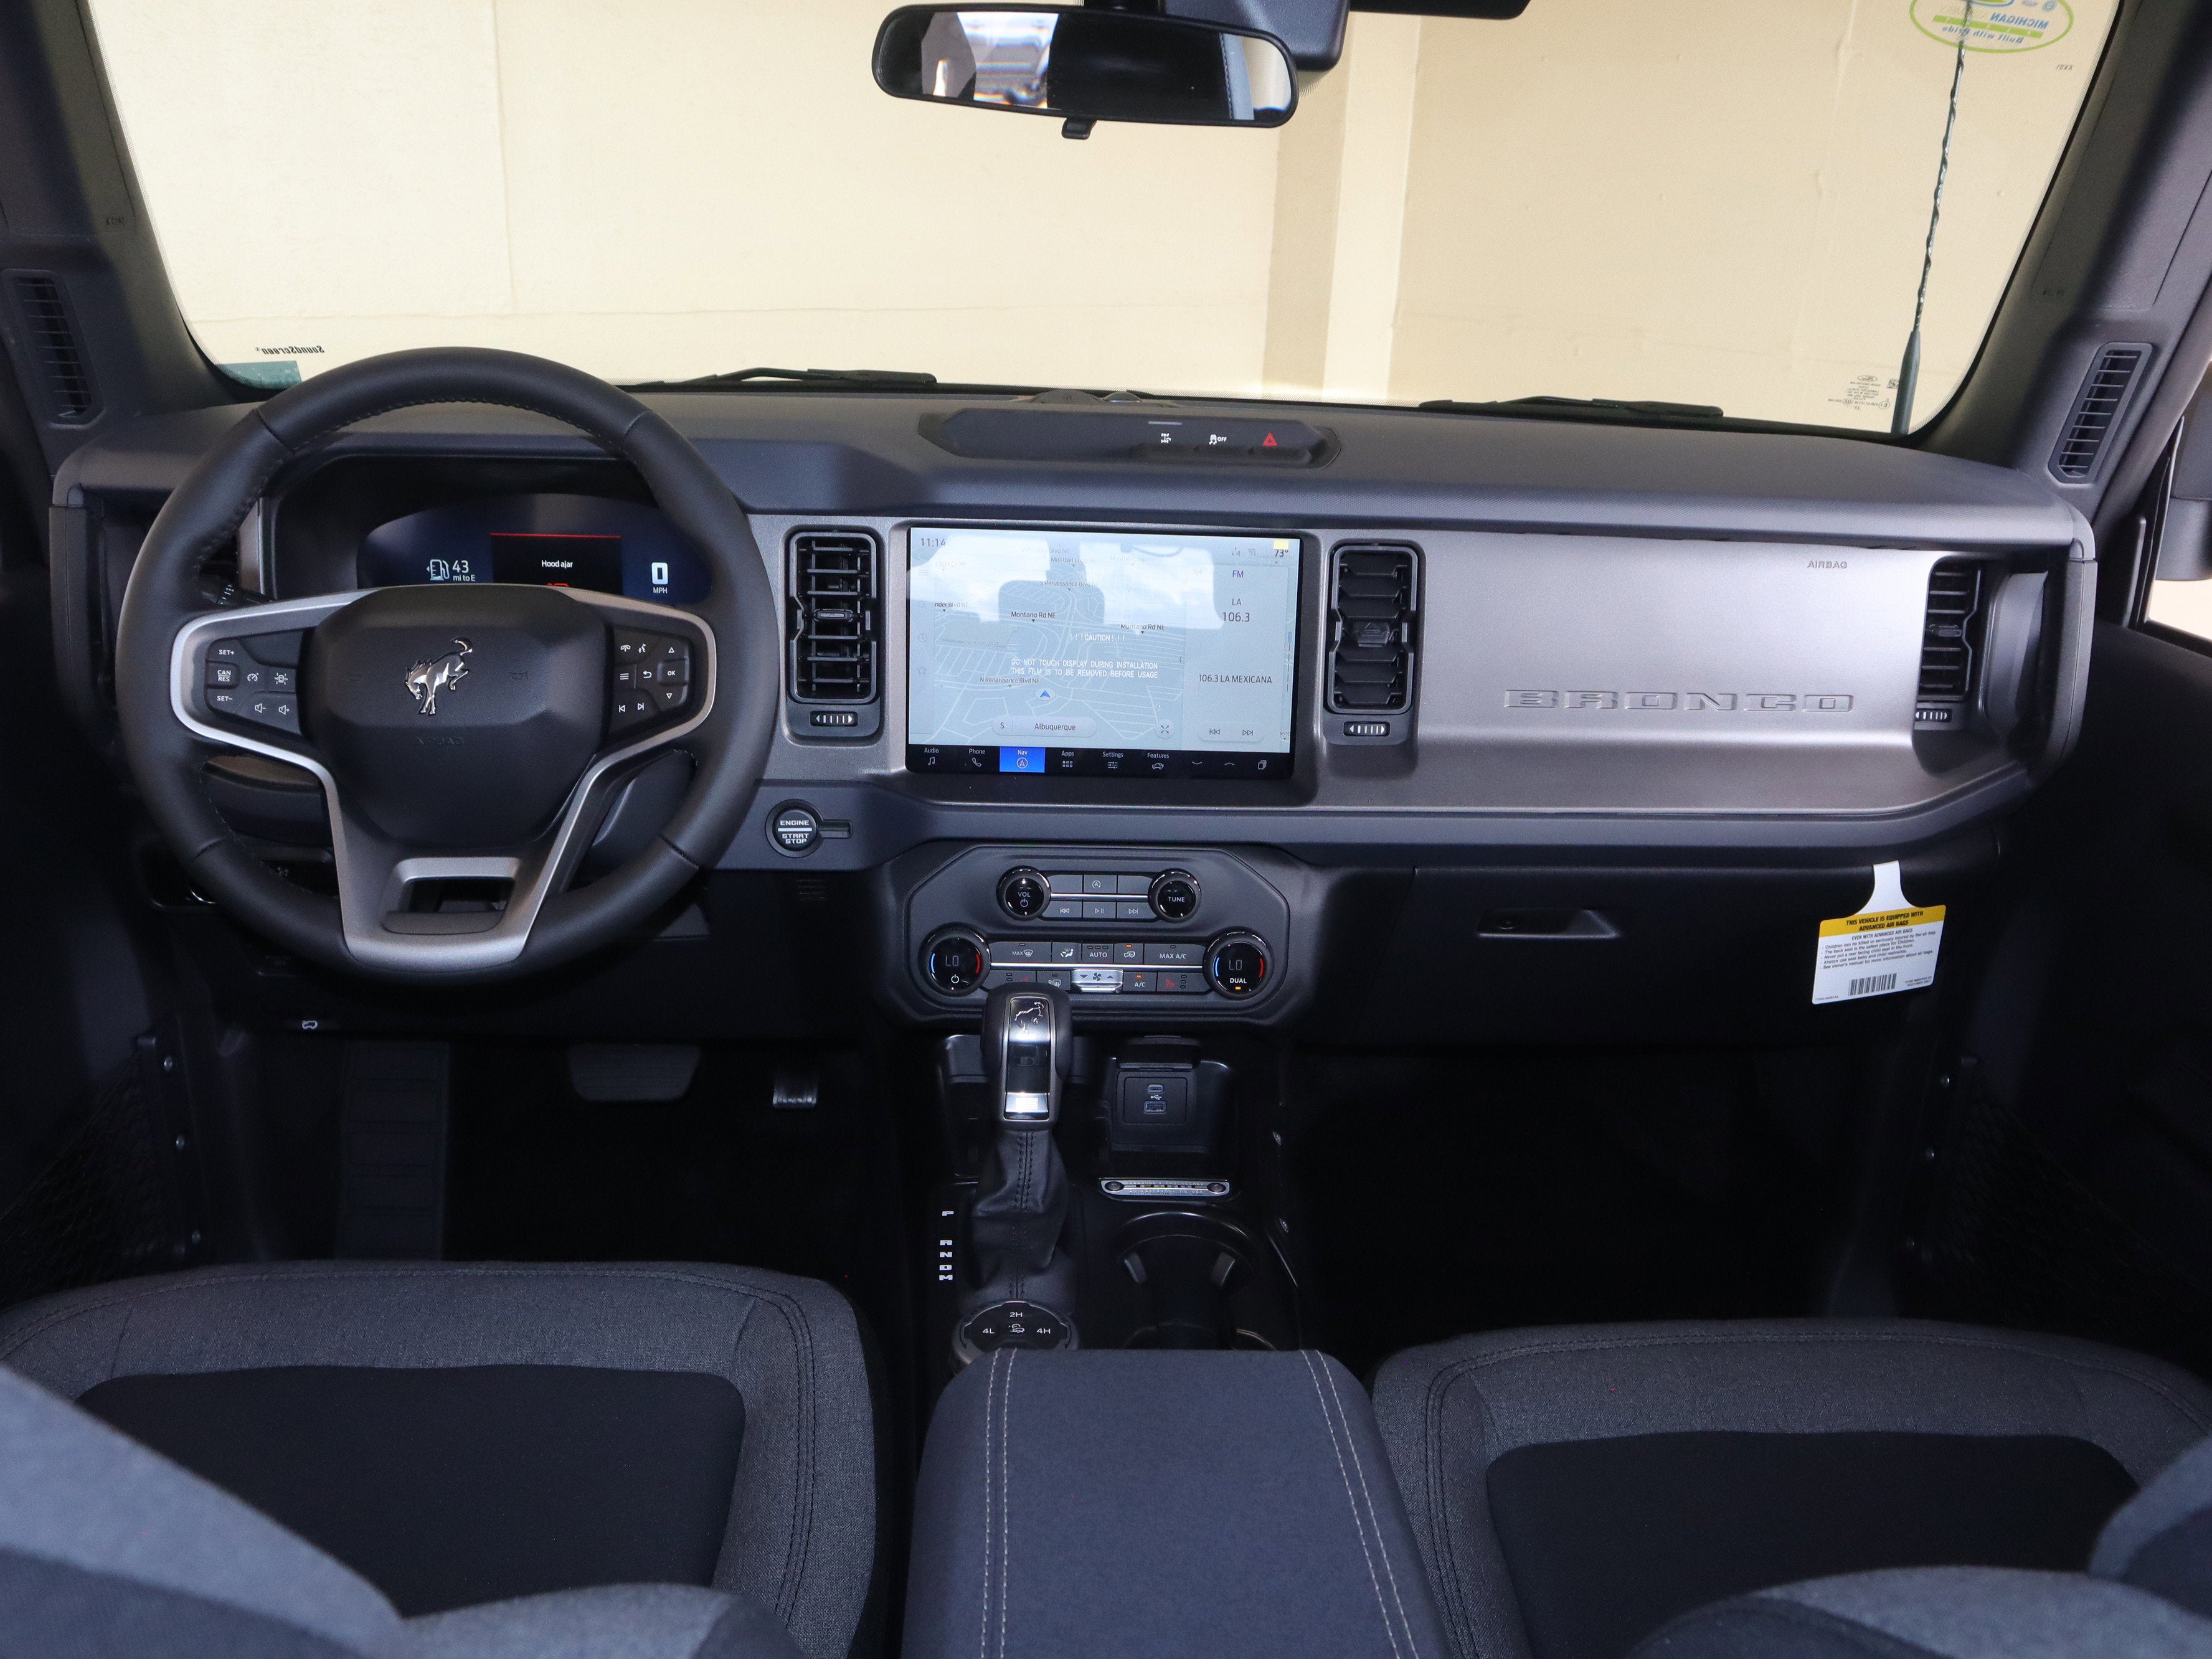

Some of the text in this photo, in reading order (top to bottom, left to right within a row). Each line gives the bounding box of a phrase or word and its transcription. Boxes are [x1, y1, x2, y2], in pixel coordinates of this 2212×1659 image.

[921, 538, 945, 547] 11:14
[452, 560, 469, 573] 43
[560, 560, 574, 569] ajar
[1807, 560, 1848, 569] AIRBAG
[651, 562, 668, 585] 0
[1222, 612, 1250, 622] 106.3
[1199, 674, 1219, 683] 106.3
[1232, 675, 1272, 684] MEXICANA
[1504, 689, 1854, 712] BRONCO
[1034, 722, 1076, 732] Albuquerque
[1102, 751, 1124, 759] Settings
